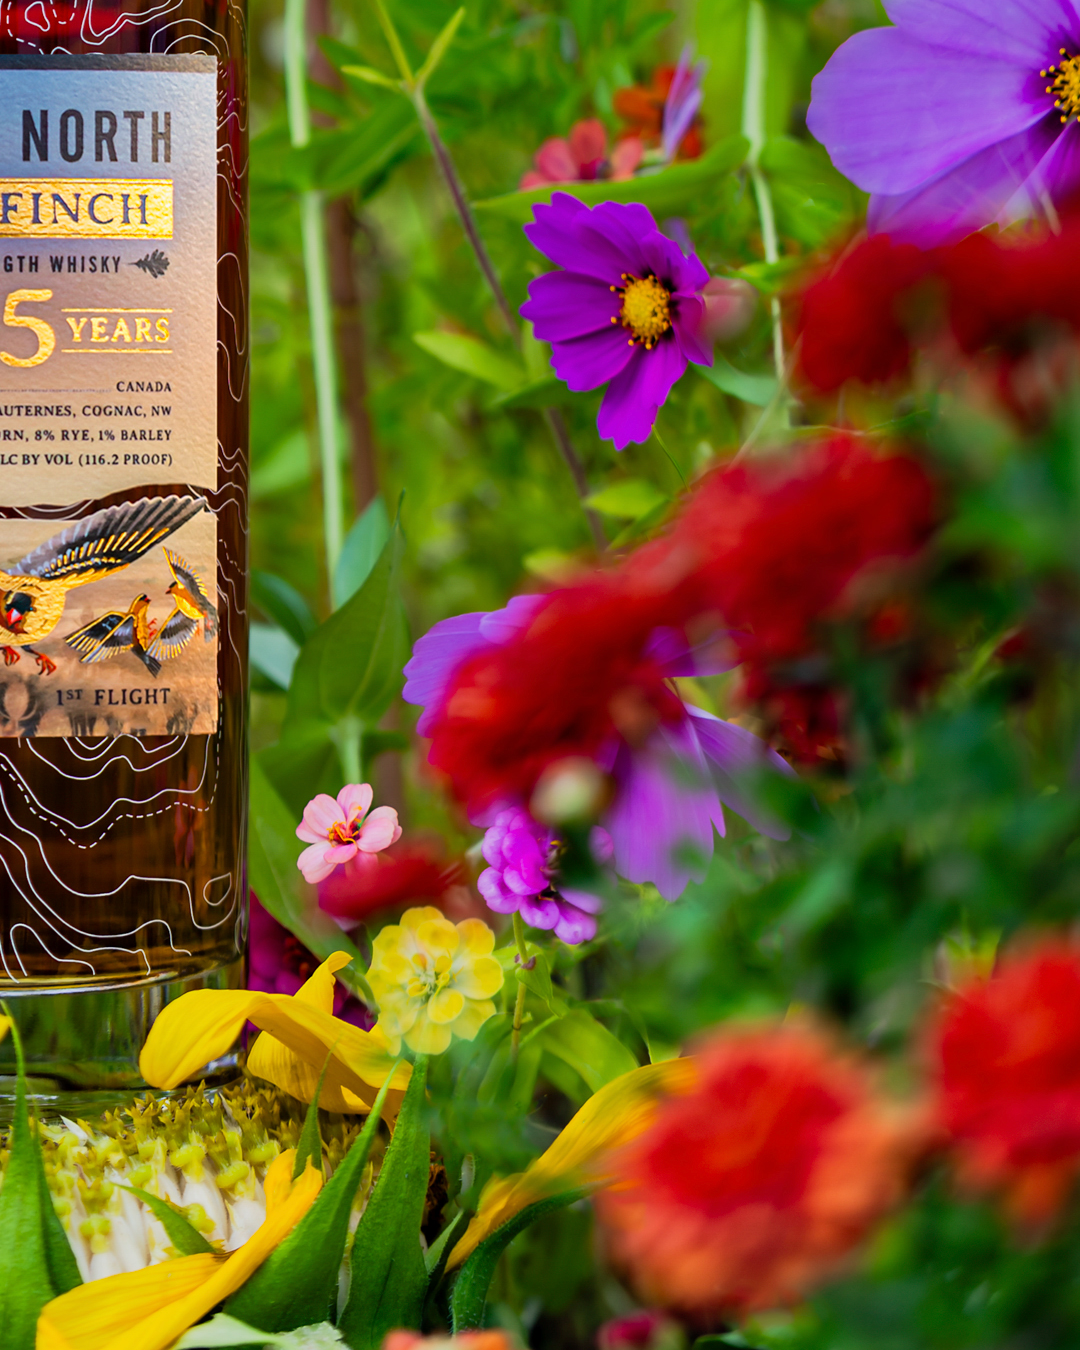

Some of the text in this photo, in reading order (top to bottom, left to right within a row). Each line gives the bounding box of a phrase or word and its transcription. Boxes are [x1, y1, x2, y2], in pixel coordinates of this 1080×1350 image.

[23, 109, 171, 163] NORTH
[50, 256, 121, 273] WHISKY
[66, 317, 170, 343] YEARS
[116, 381, 172, 392] CANADA
[82, 405, 147, 418] COGNAC,
[151, 405, 172, 416] NW
[34, 430, 55, 441] 8%
[61, 430, 94, 442] RYE,
[99, 430, 115, 441] 1%
[121, 430, 172, 441] BARLEY
[22, 454, 40, 465] BY
[45, 454, 73, 465] VOL
[79, 454, 119, 467] (116.2
[124, 454, 172, 467] PROOF)
[56, 688, 171, 706] 1ST FLIGHT
